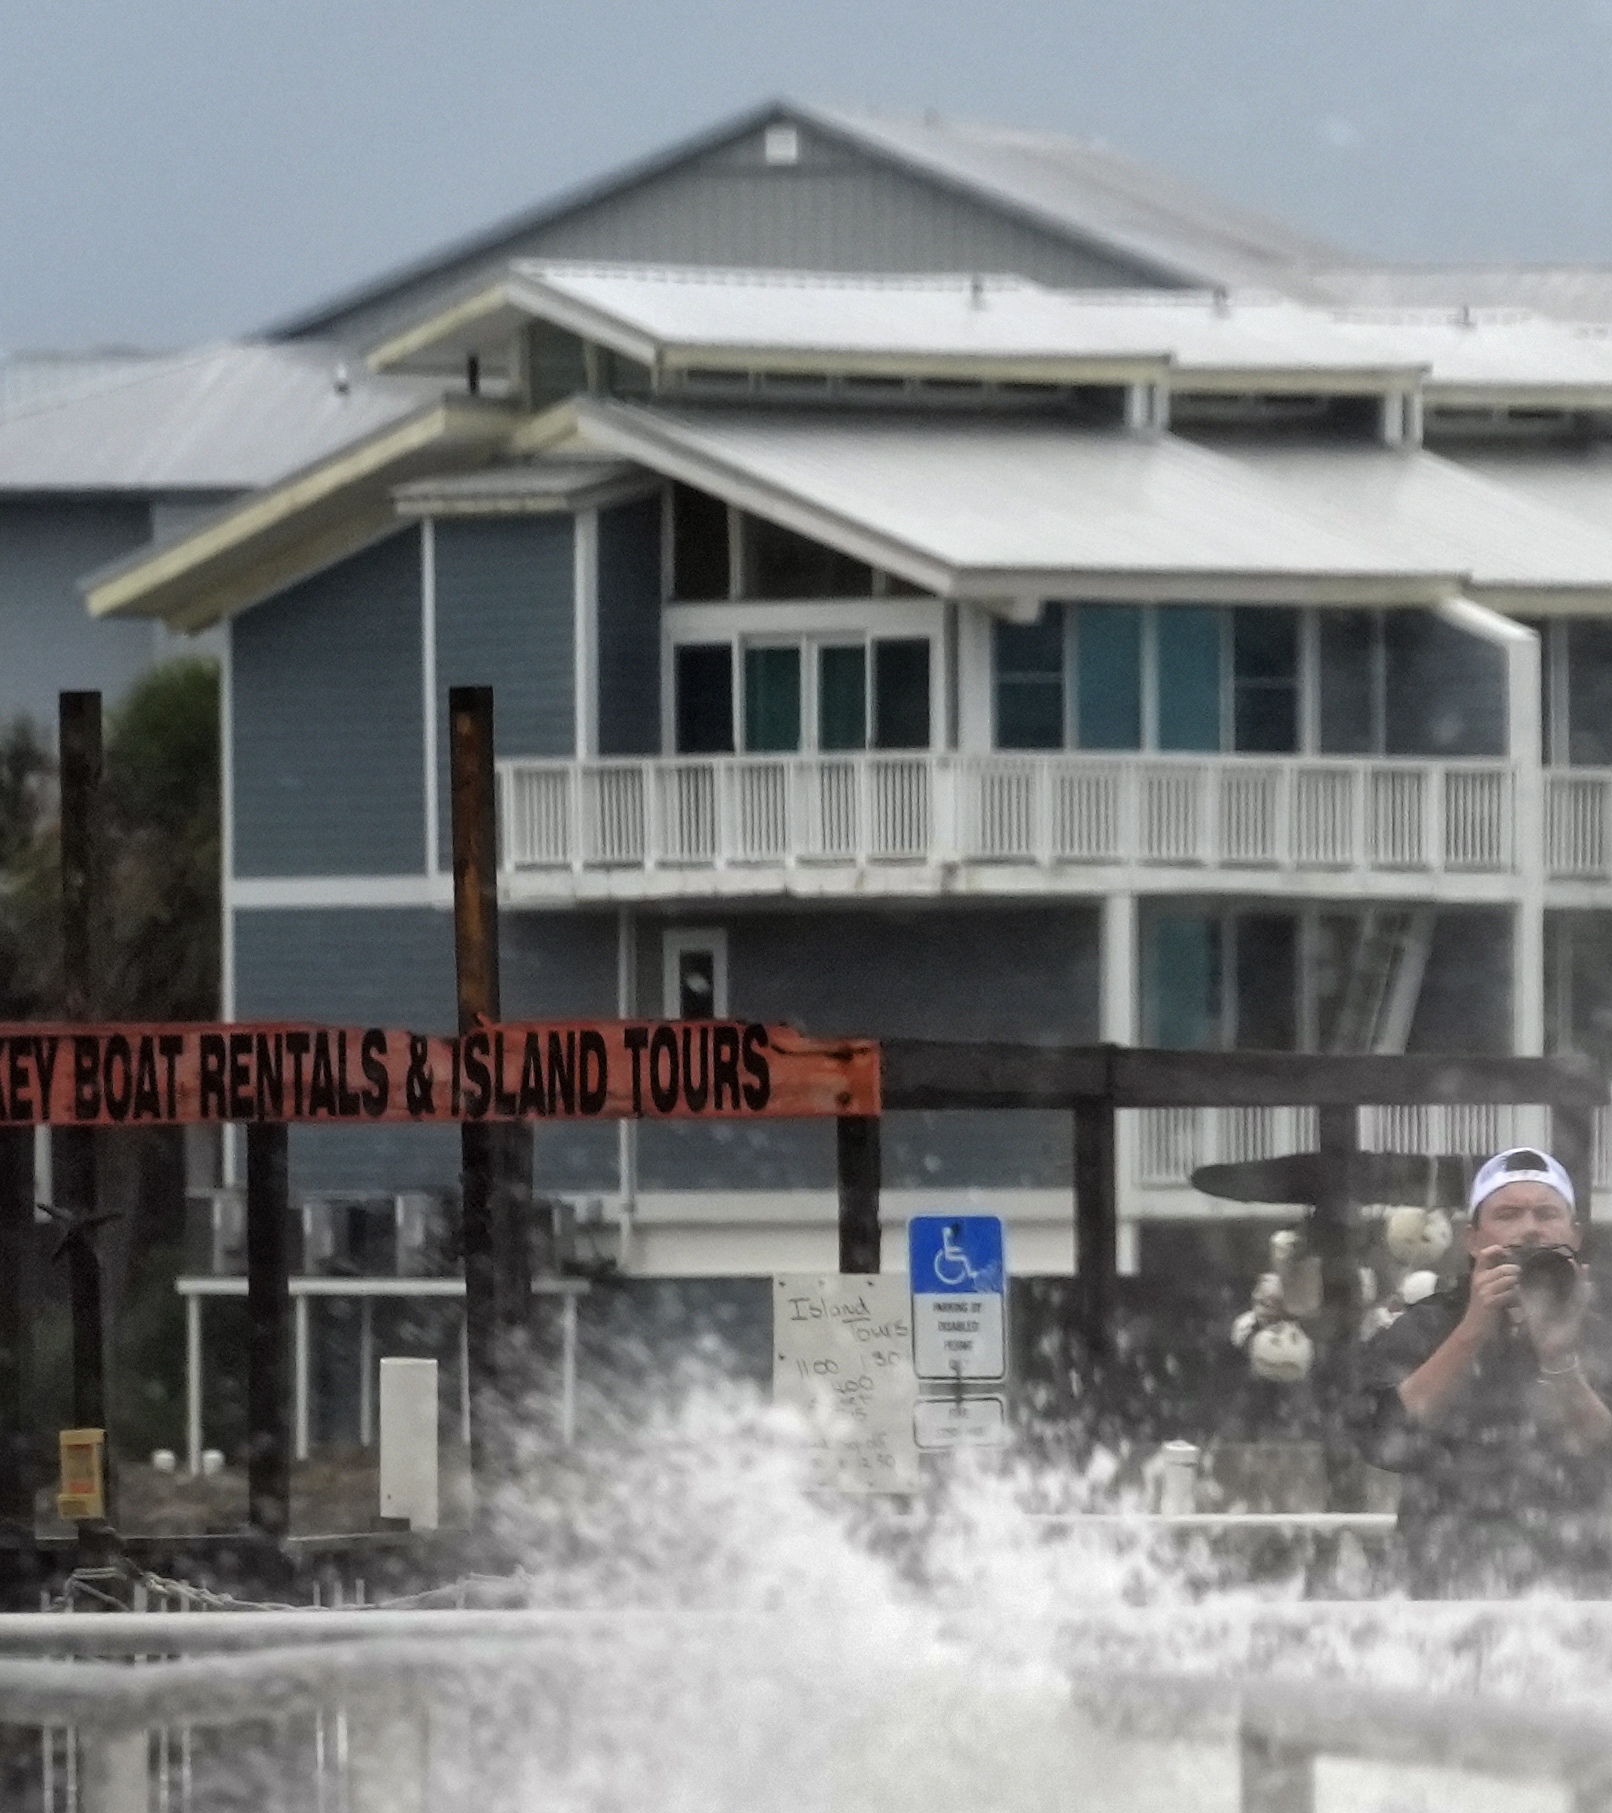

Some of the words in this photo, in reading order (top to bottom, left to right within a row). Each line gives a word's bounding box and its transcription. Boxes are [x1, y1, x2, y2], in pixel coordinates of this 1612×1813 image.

[0, 1034, 58, 1121] EY
[74, 1032, 183, 1121] BOAT
[200, 1026, 388, 1119] RENTALS
[406, 1034, 433, 1116] &
[451, 1030, 607, 1117] ISLAND
[624, 1023, 770, 1112] TOURS
